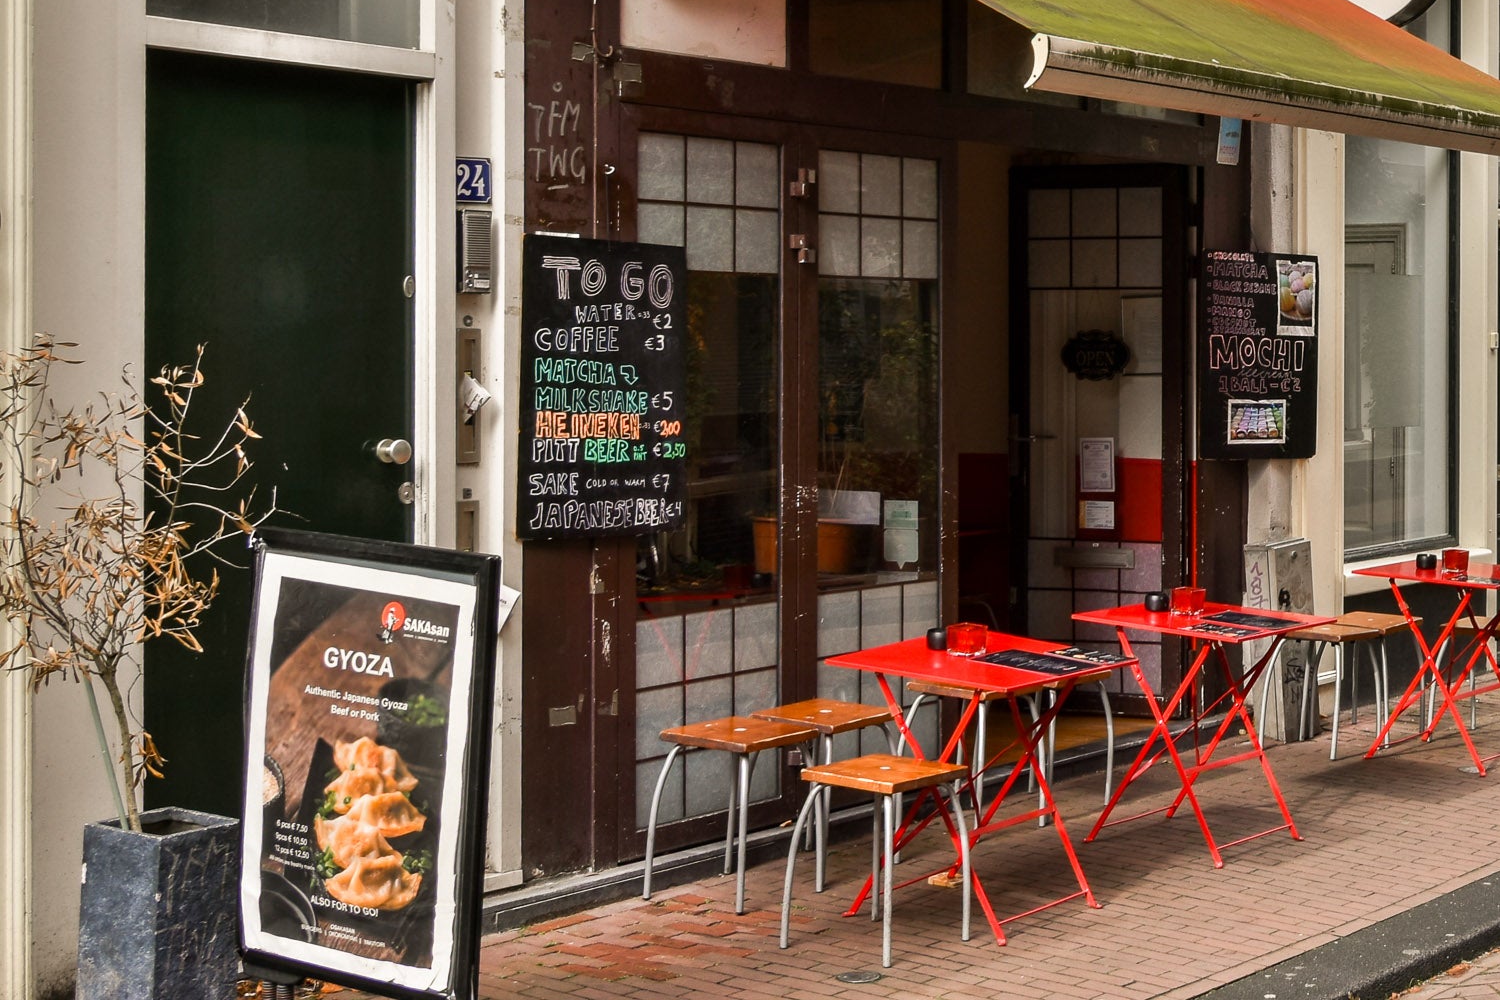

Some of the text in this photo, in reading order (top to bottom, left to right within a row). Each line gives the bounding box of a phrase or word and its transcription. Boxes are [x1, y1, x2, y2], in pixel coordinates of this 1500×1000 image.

[457, 164, 486, 197] 24
[542, 255, 674, 309] TO GO
[1213, 261, 1269, 280] MATCHA
[1212, 293, 1255, 308] VANILLA
[1212, 305, 1252, 320] MANGO
[575, 302, 636, 324] WATER
[534, 325, 665, 353] COFFEE €3
[1076, 350, 1116, 367] OPEN
[1209, 334, 1305, 372] MOCHI
[535, 357, 617, 385] MATCHA
[1231, 376, 1268, 394] BALL
[651, 391, 674, 411] €5
[535, 410, 640, 440] HEINEKEN
[532, 438, 580, 463] PITT
[584, 438, 630, 463] BEER
[529, 472, 579, 496] SAKE
[586, 478, 607, 489] COLD
[625, 478, 647, 487] WARM
[530, 499, 633, 530] JAPANESE
[634, 498, 669, 527] BEER
[403, 617, 450, 638] SAKAsan
[323, 646, 395, 678] GYOZA
[304, 684, 408, 711] Authentic Japanese Gyoza
[331, 704, 380, 722] Beef or Pork
[310, 894, 379, 917] ALSO FOR TO GO!
